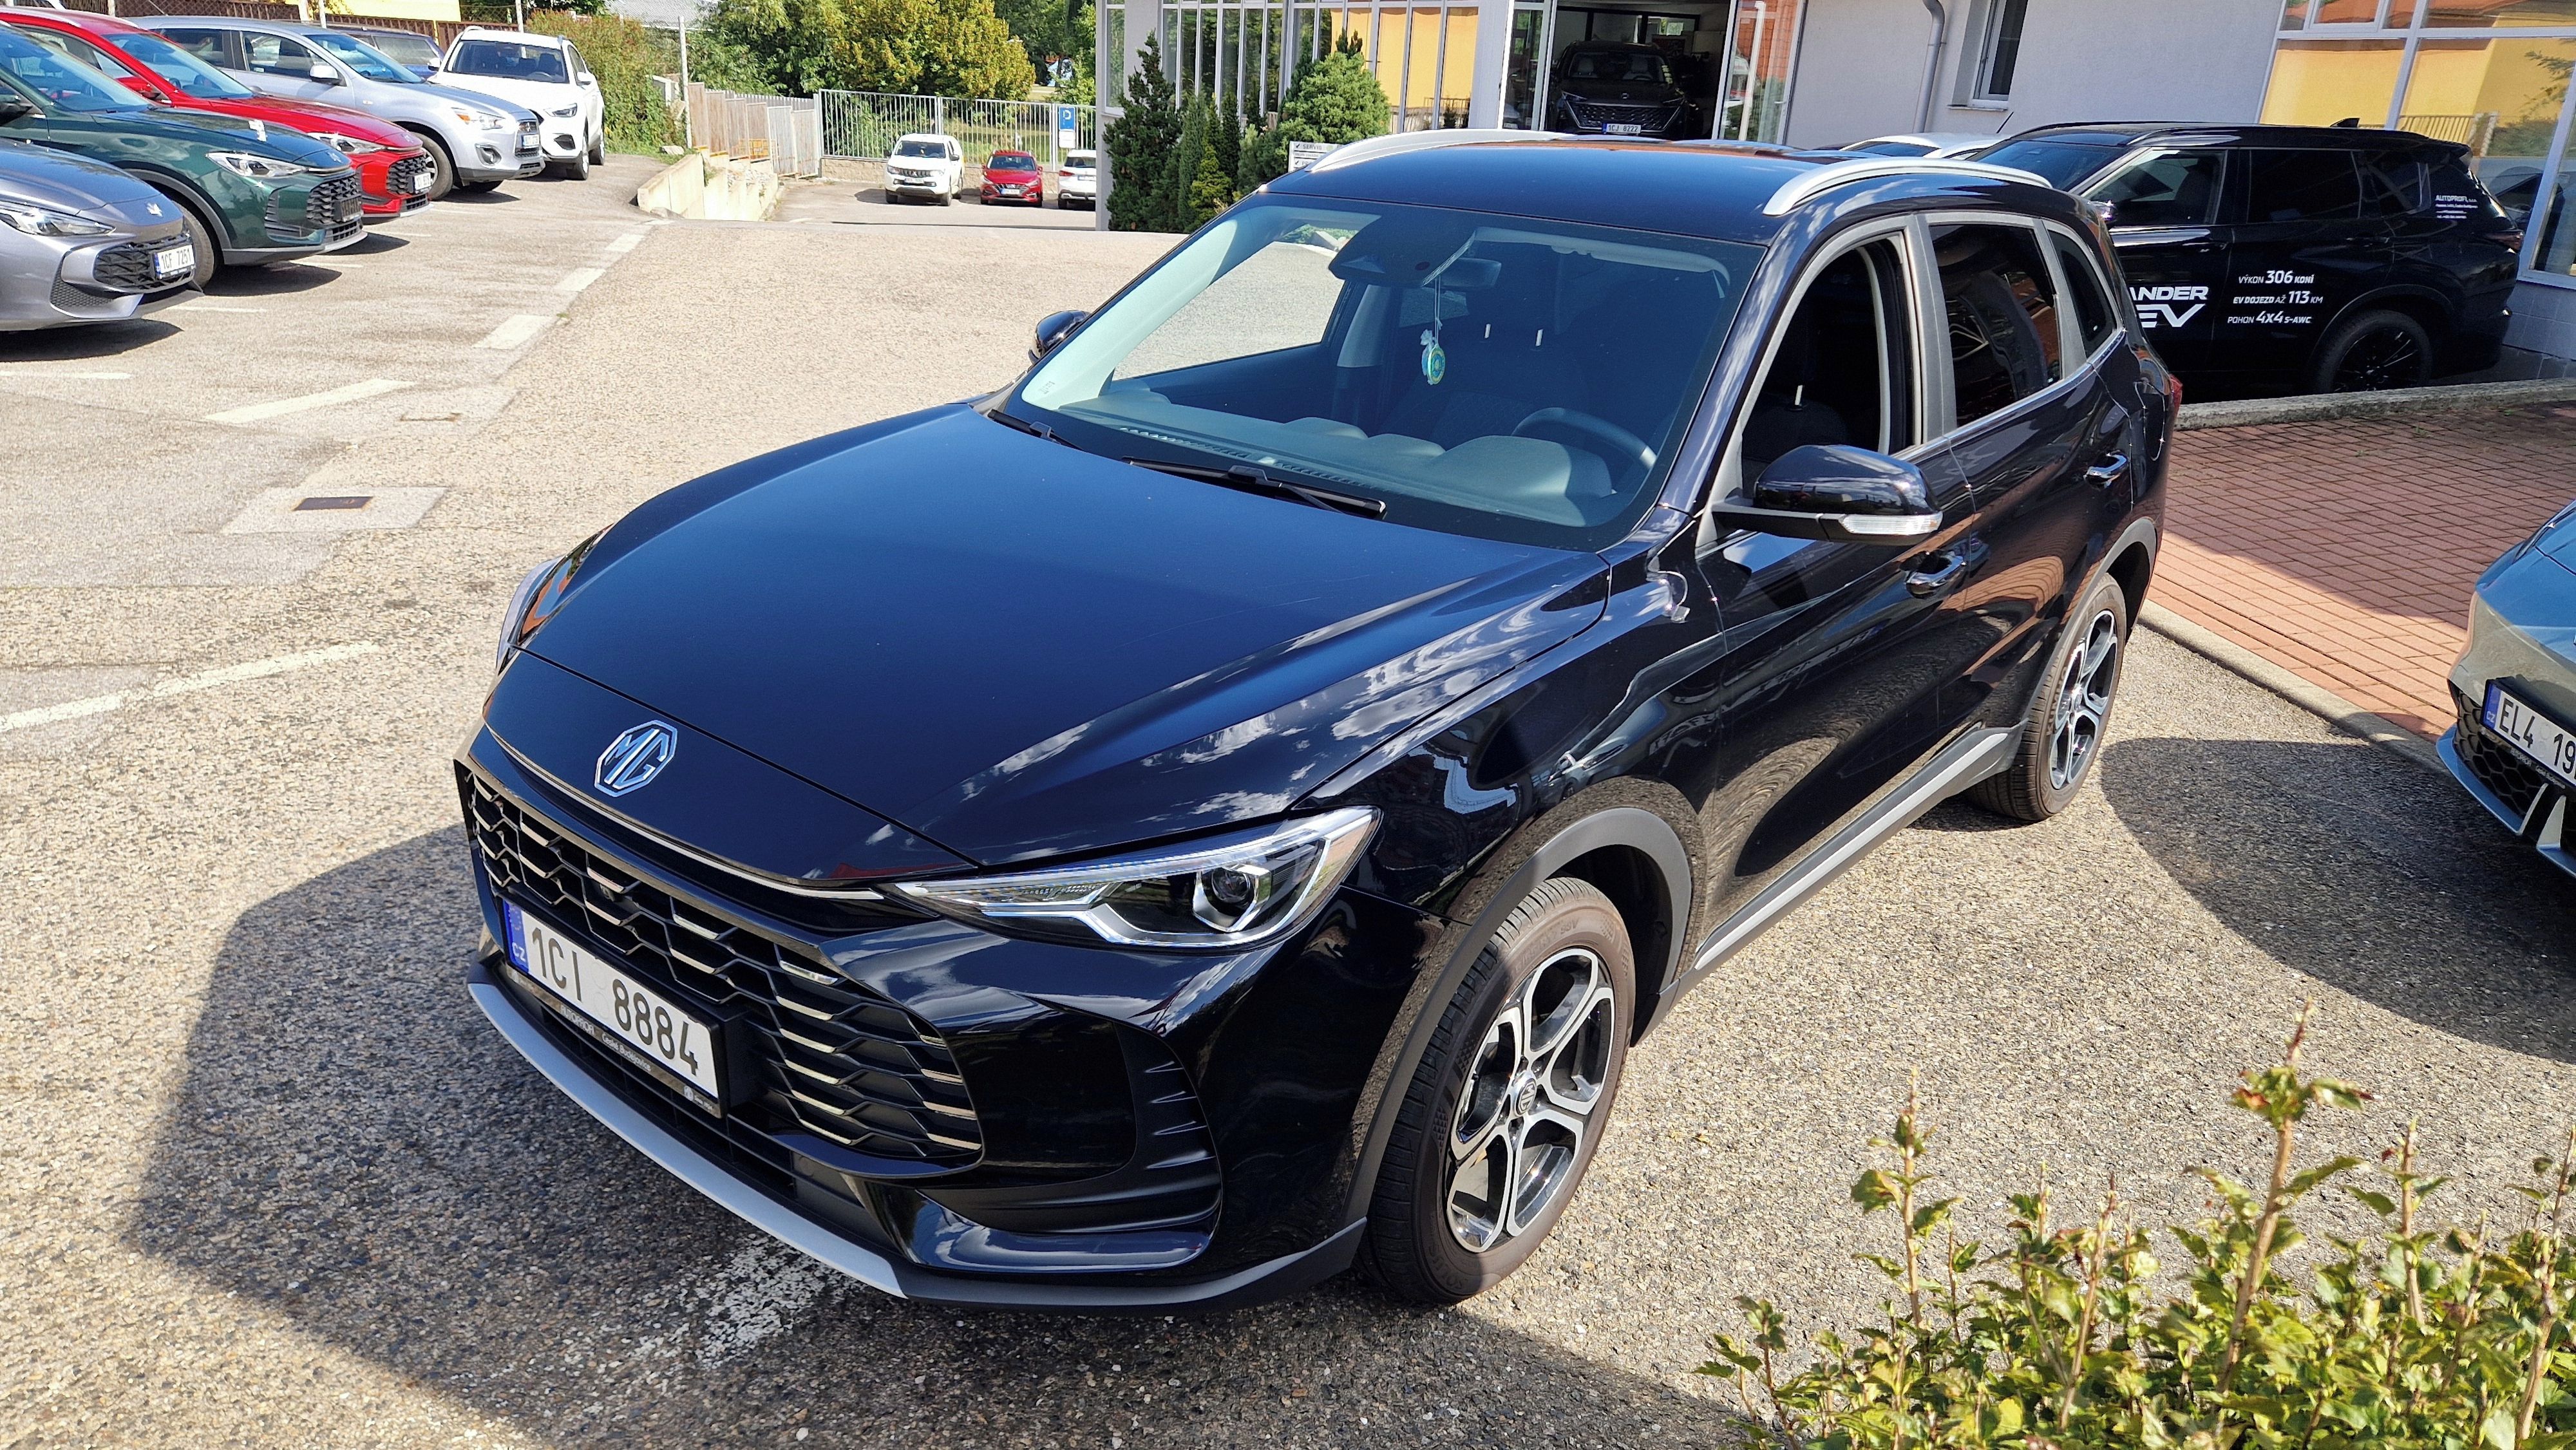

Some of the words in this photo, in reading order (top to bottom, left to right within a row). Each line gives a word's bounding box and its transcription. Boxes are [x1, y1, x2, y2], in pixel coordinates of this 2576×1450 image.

[161, 253, 172, 270] 1CF
[176, 248, 191, 266] 7251
[2239, 274, 2264, 284] VÝKON
[2265, 270, 2293, 284] 306
[2288, 290, 2311, 304] 113
[2486, 711, 2496, 723] CZ
[2499, 698, 2535, 749] EL4
[2553, 733, 2576, 780] 19
[601, 726, 672, 792] MG
[512, 941, 527, 963] CZ
[612, 979, 698, 1077] 8884
